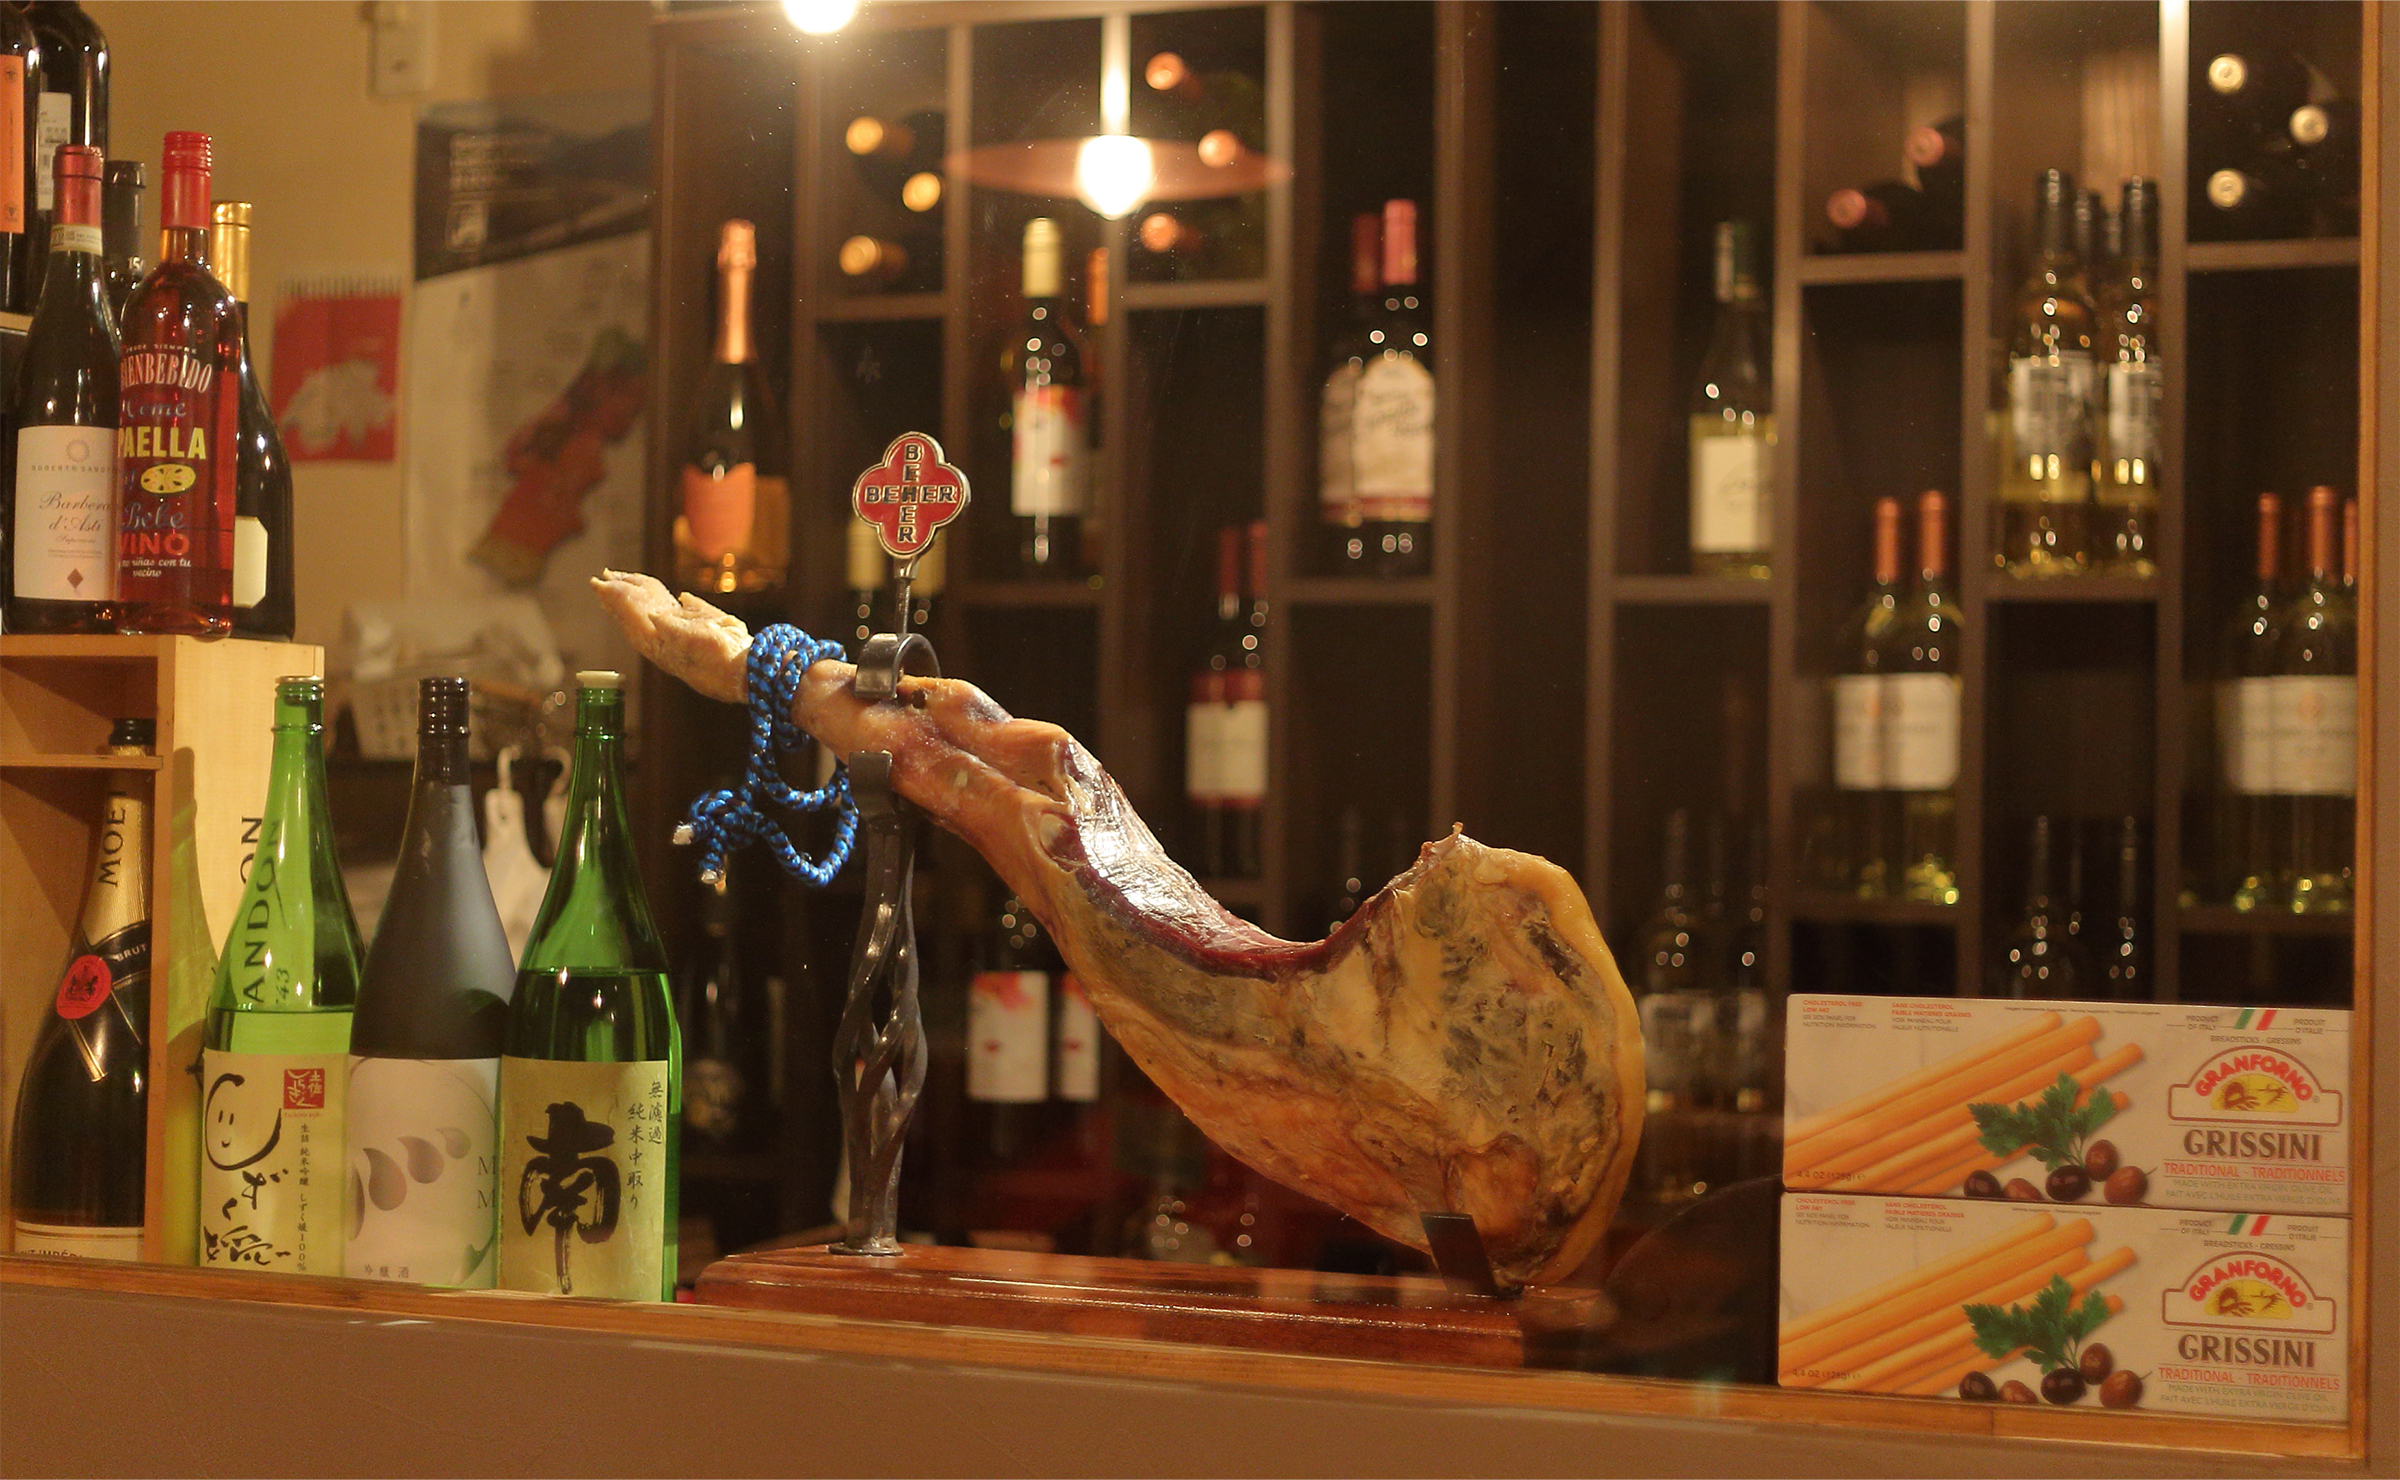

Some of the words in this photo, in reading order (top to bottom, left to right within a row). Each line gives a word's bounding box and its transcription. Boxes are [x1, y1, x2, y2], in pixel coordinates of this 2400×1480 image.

[38, 491, 112, 510] Barbera
[864, 485, 958, 504] BEHER
[897, 442, 923, 543] BEHER
[49, 514, 101, 532] d'Asti
[158, 559, 177, 567] con
[179, 558, 192, 567] tu
[116, 943, 147, 962] BRUT
[2186, 1015, 2219, 1023] PRODUCT
[2211, 1035, 2260, 1044] BREADSTICKS
[2267, 1037, 2302, 1045] GRESSINS
[2195, 1054, 2313, 1101] GRANFORNO
[648, 1081, 665, 1145] 無濾過
[2183, 1129, 2322, 1162] GRISSINI
[626, 1103, 647, 1211] 純米中取り
[2164, 1162, 2240, 1177] TRADITIONAL
[2251, 1166, 2345, 1182] TRADITIONNELS
[2173, 1180, 2199, 1188] MADE
[2227, 1182, 2257, 1190] EXTRA
[2258, 1183, 2287, 1192] VIRGIN
[2291, 1184, 2316, 1193] OLIVE
[2186, 1190, 2207, 1199] AVEC
[2245, 1193, 2272, 1202] EXTRA
[518, 1101, 621, 1295] 南
[2179, 1219, 2212, 1227] PRODUCT
[2287, 1225, 2319, 1233] PRODUIT
[2203, 1240, 2253, 1248] BREADSTICKS
[2260, 1243, 2296, 1251] GRESSINS
[2189, 1260, 2307, 1308] GRANFORNO
[2178, 1334, 2315, 1368] GRISSINI
[2159, 1367, 2235, 1383] TRADITIONAL
[2246, 1373, 2340, 1390] TRADITIONNELS
[2168, 1384, 2194, 1393] MADE
[2196, 1385, 2220, 1394] WITH
[2222, 1387, 2250, 1395] EXTRA
[2252, 1389, 2283, 1398] VIRGIN
[2286, 1392, 2311, 1400] OLIVE
[2181, 1396, 2203, 1404] AVEC
[2239, 1399, 2269, 1408] EXTRA
[2270, 1402, 2300, 1411] VIERGE
